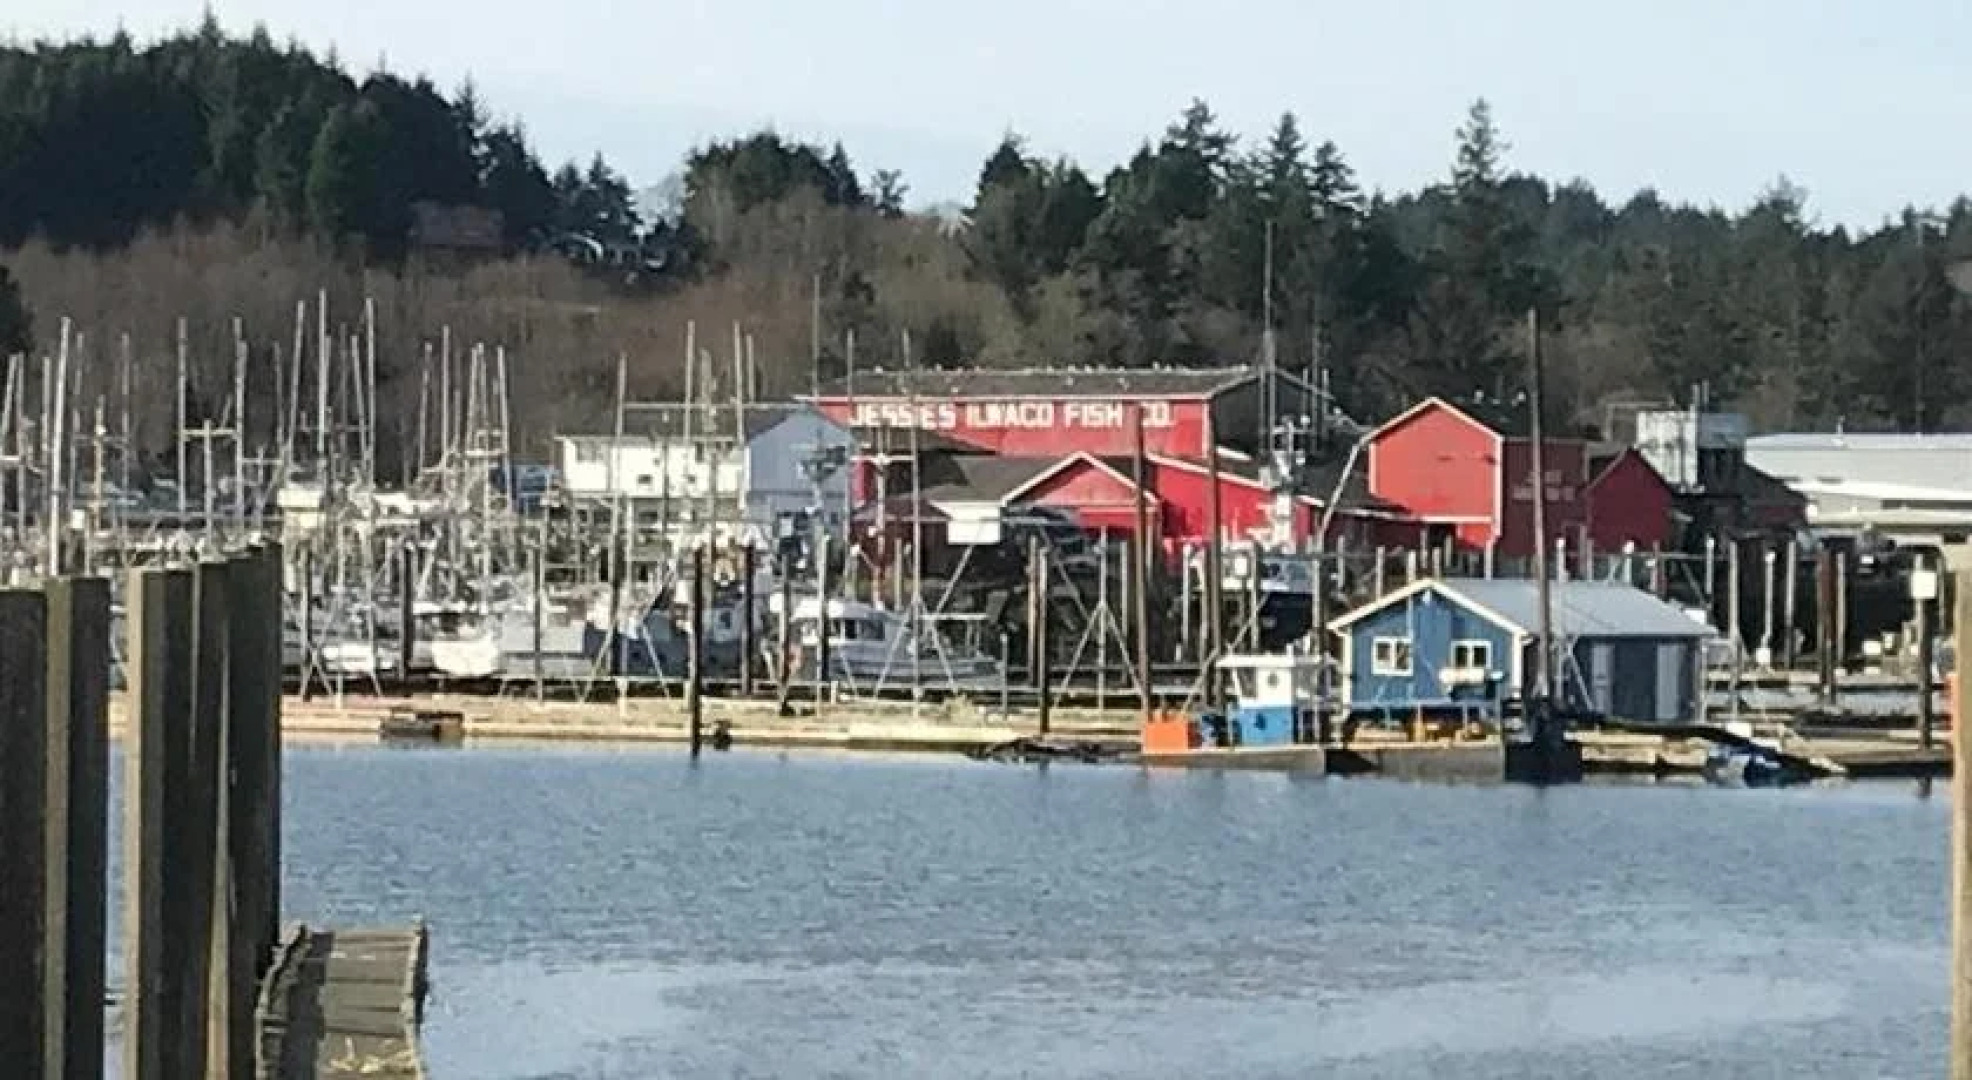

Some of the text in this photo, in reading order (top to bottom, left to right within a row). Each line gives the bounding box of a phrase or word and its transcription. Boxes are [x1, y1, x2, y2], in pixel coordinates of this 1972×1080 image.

[850, 403, 956, 429] JESSES
[966, 403, 1053, 428] ILWACO
[1063, 403, 1122, 428] FISH
